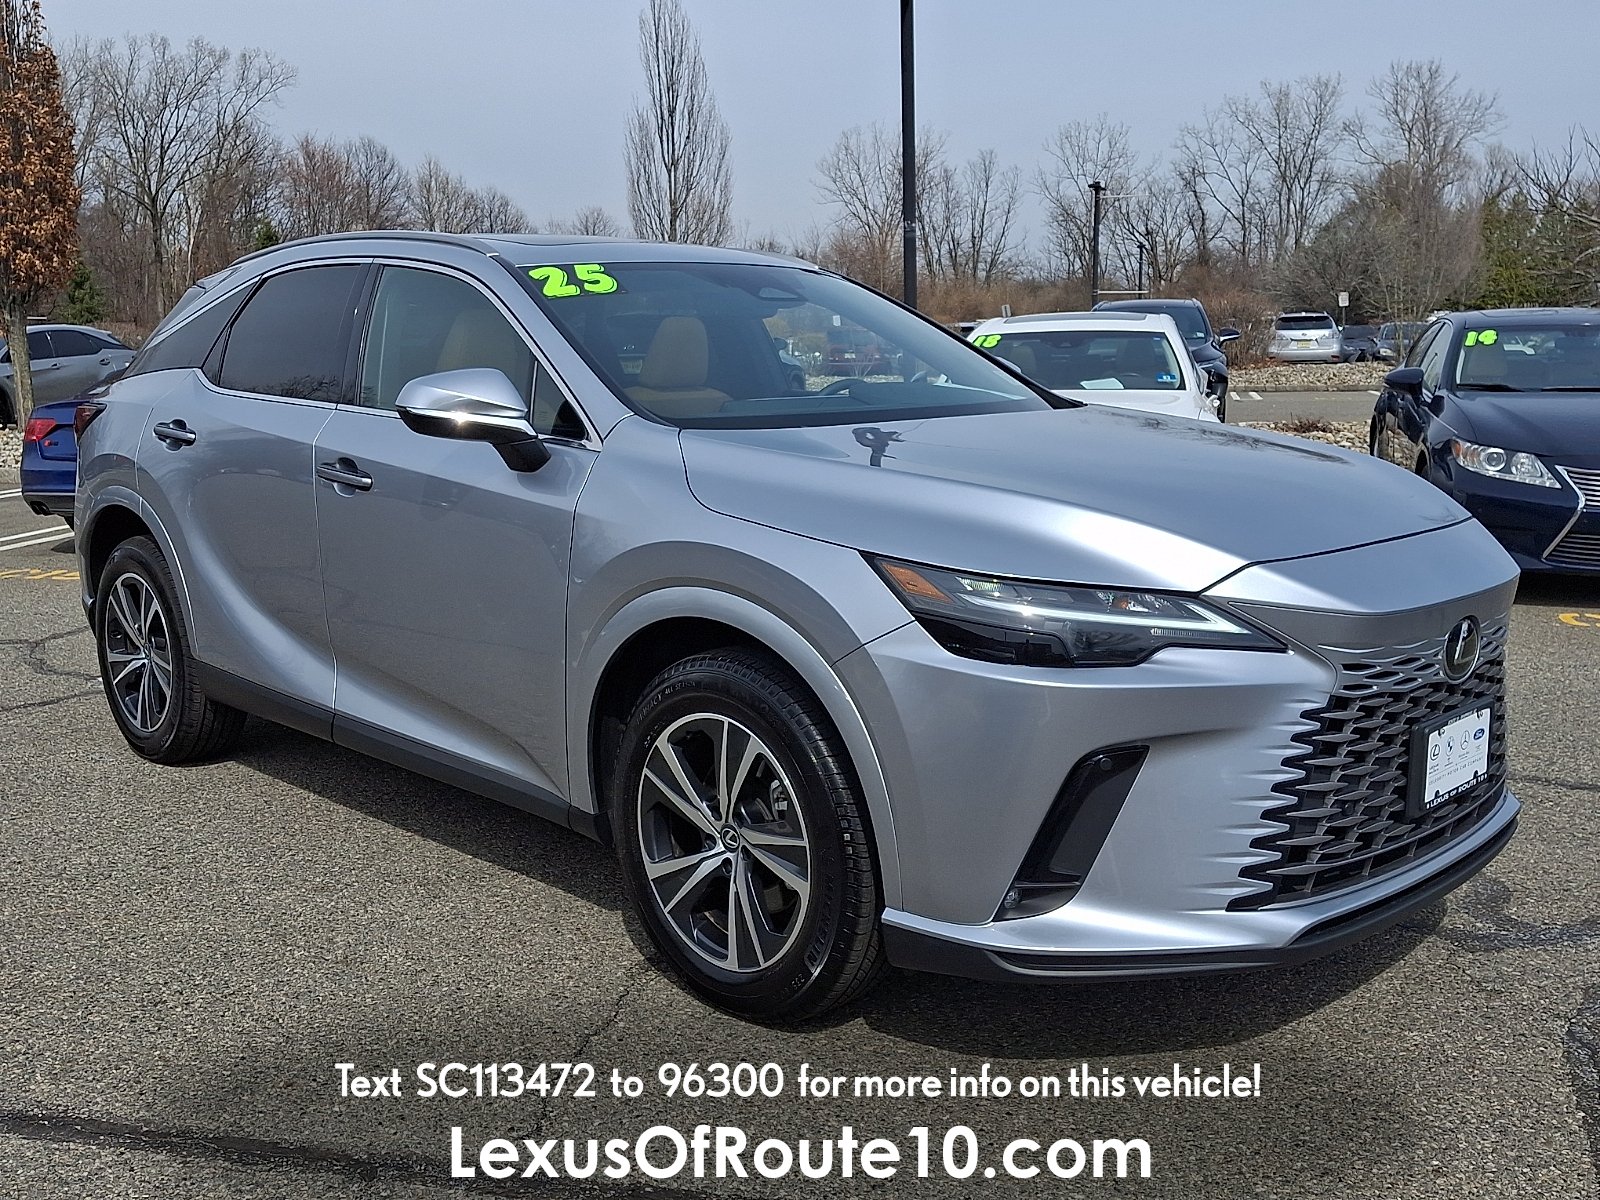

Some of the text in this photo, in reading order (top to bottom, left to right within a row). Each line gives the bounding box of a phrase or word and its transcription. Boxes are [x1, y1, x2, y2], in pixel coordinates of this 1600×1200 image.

[528, 263, 618, 298] 25
[973, 334, 1002, 348] 18
[1464, 329, 1498, 347] 14
[1430, 793, 1449, 807] LEXUS
[1458, 778, 1477, 793] ROUTE
